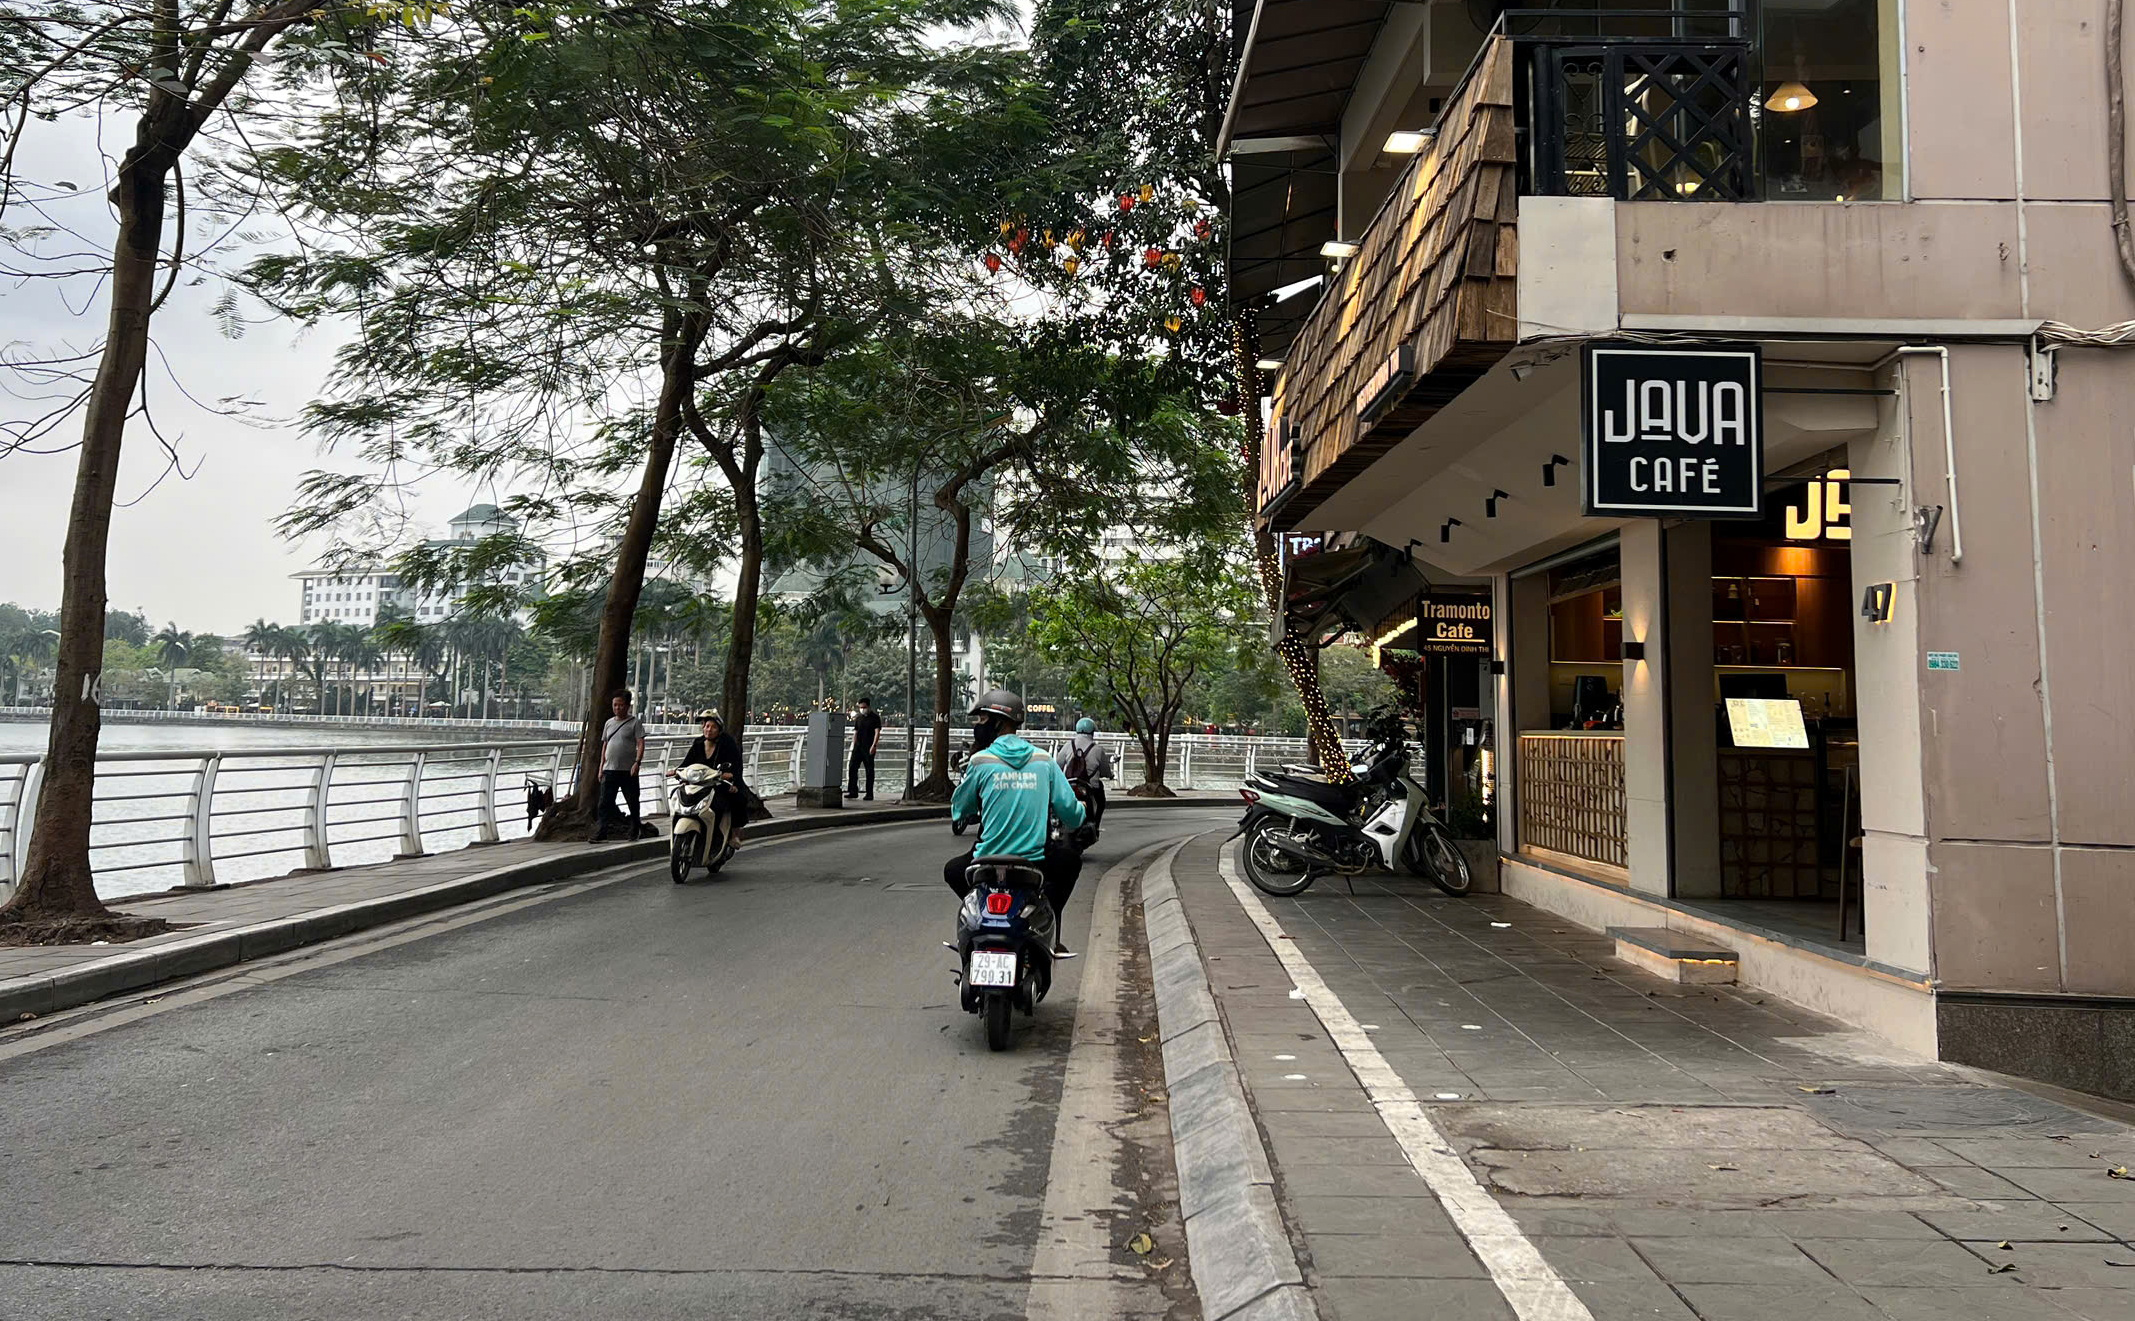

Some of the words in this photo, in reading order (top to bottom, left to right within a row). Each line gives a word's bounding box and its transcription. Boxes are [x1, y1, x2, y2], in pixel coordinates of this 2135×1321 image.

[1604, 379, 1745, 445] JAVA
[1629, 456, 1721, 493] CAFÉ
[1421, 600, 1490, 619] Tramonto
[1861, 583, 1897, 624] 47
[1436, 622, 1473, 638] Cafe
[977, 954, 1009, 969] 29-AC
